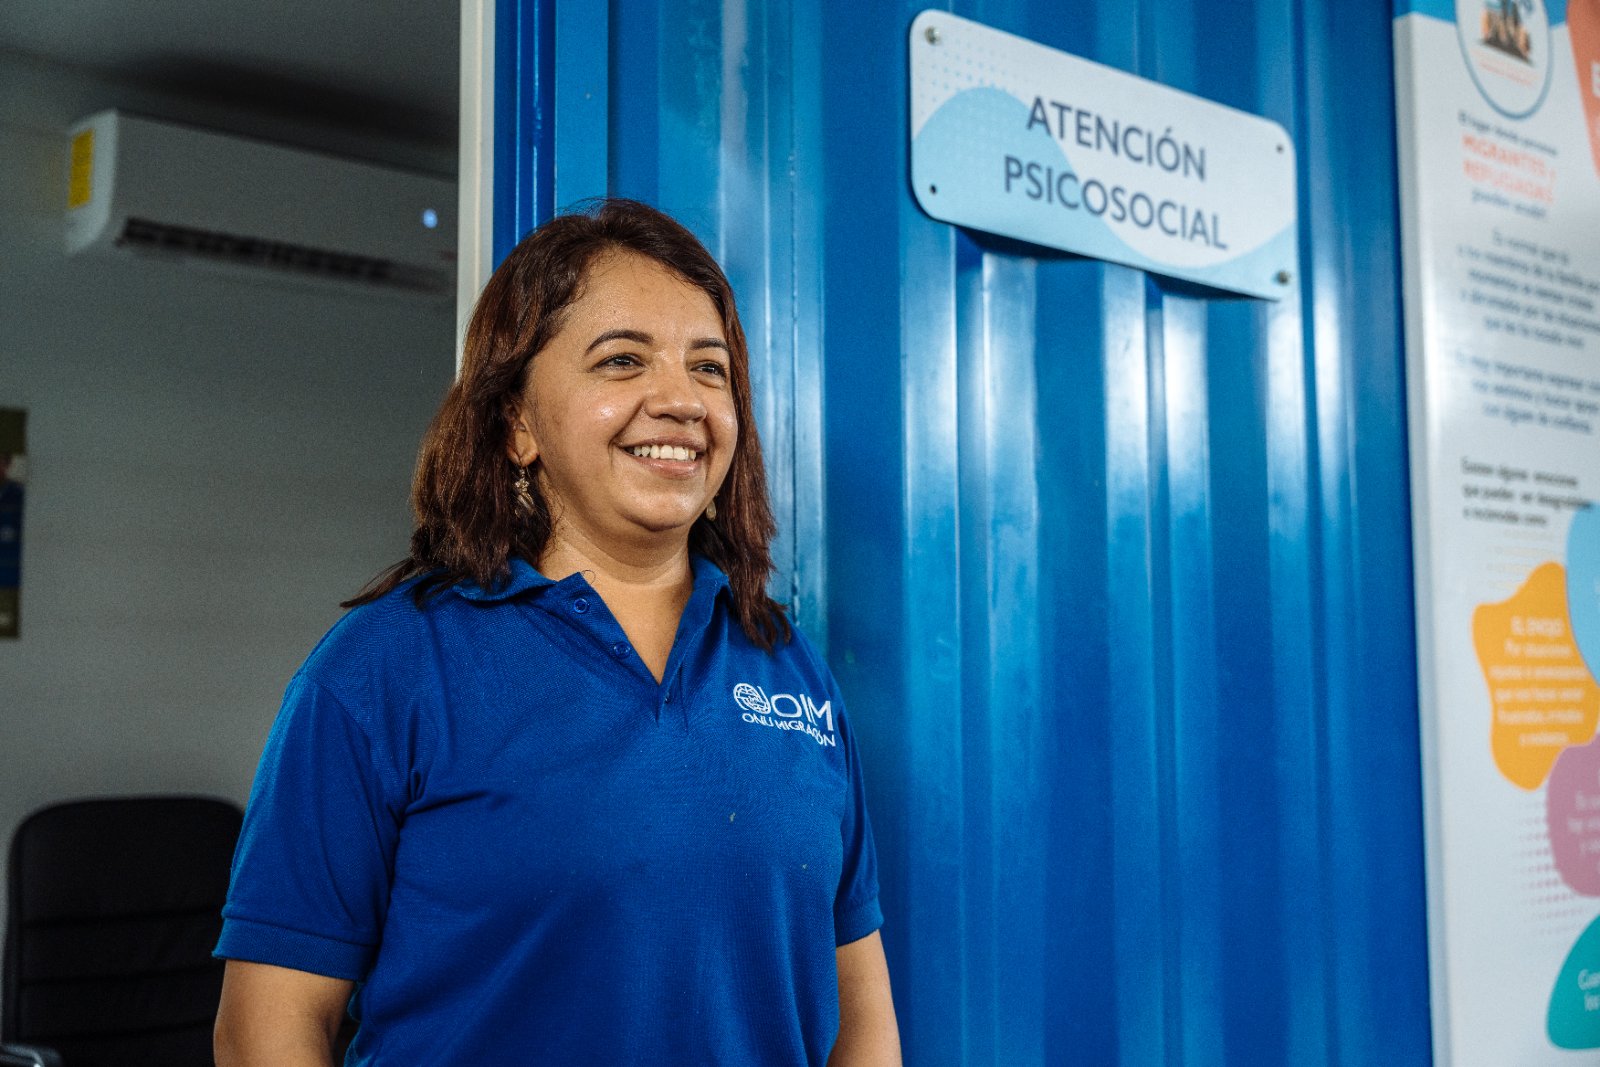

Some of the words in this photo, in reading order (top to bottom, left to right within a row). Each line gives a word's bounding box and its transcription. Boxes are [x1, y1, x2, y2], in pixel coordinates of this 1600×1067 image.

[1027, 96, 1206, 182] ATENCIÓN
[1005, 155, 1229, 250] PSICOSOCIAL
[742, 713, 774, 727] ONU
[770, 693, 834, 731] OIM
